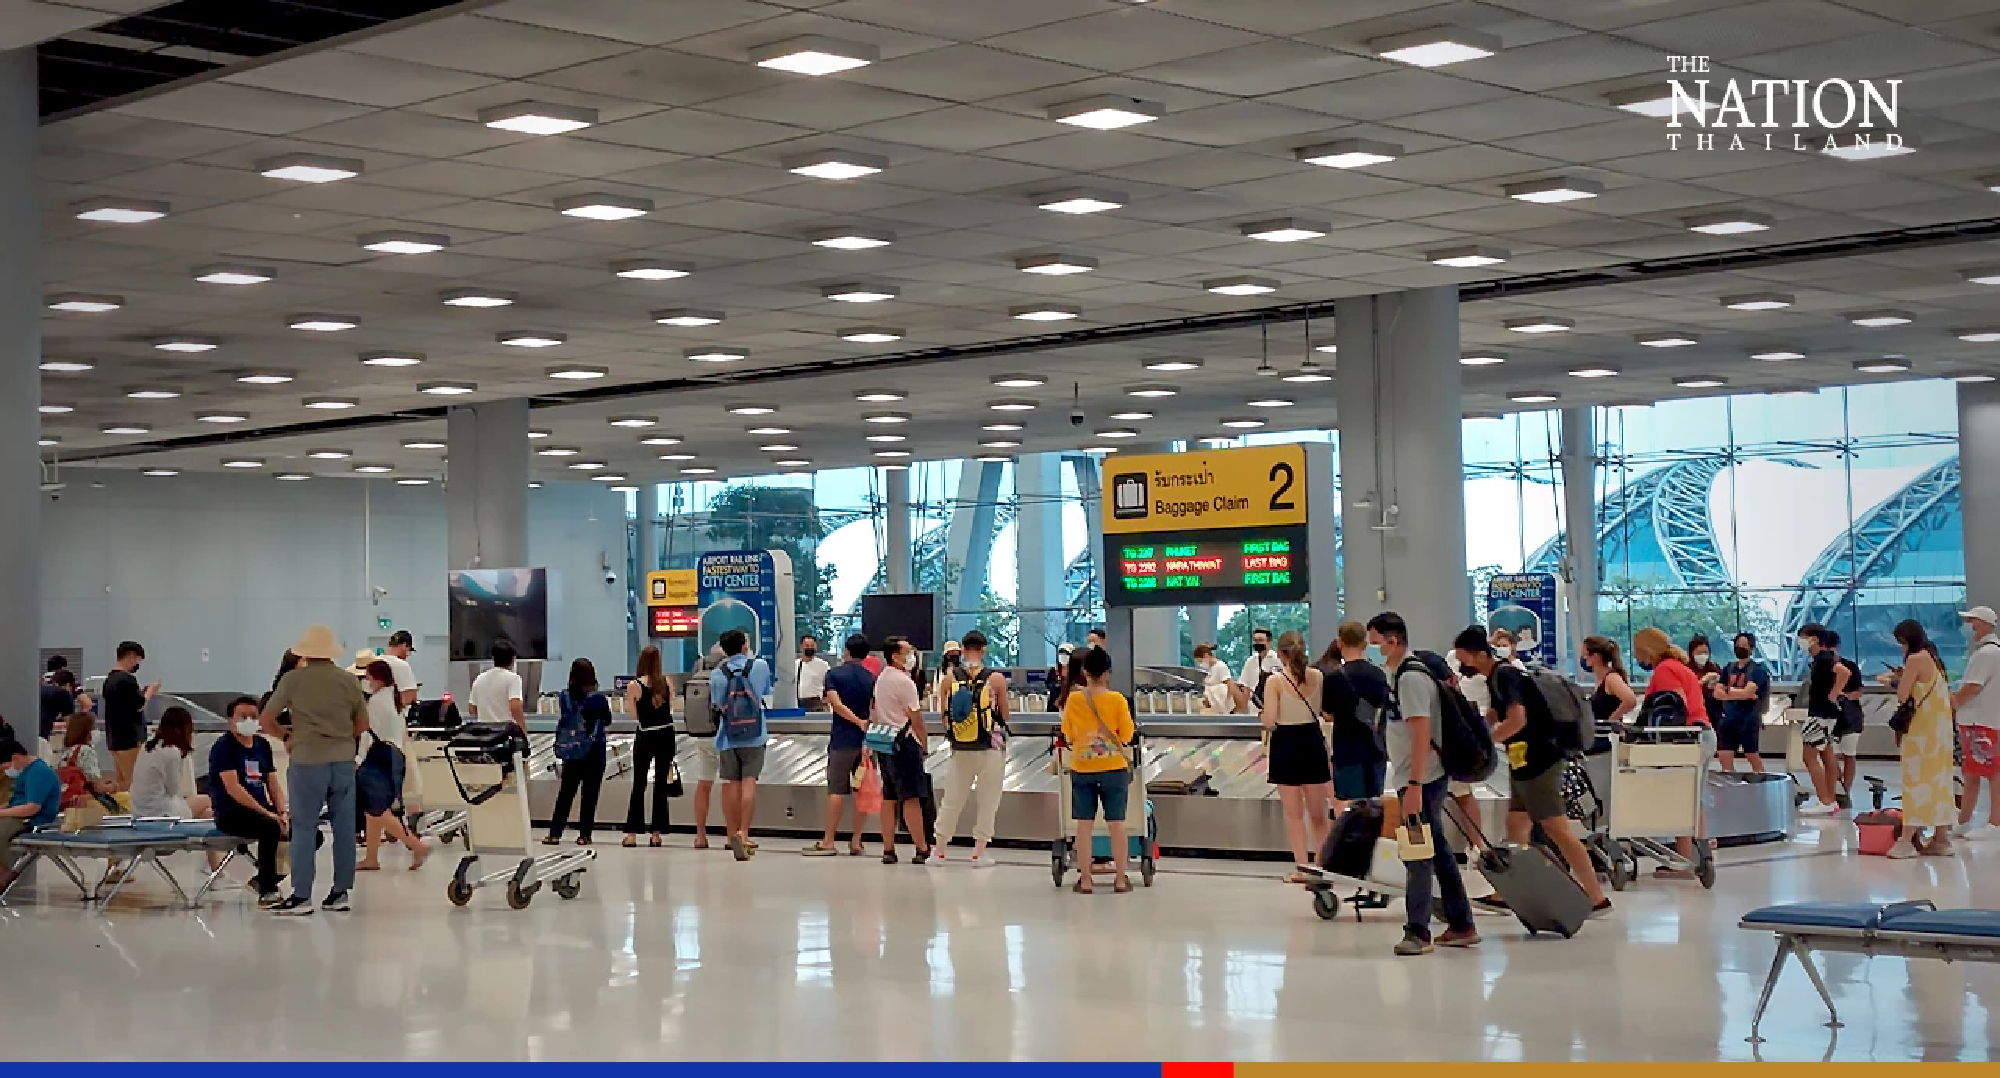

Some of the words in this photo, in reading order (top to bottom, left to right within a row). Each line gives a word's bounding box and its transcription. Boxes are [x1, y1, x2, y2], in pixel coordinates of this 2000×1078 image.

[1269, 461, 1295, 511] 2
[1156, 500, 1209, 517] Baggage
[1214, 495, 1248, 511] Claim
[1244, 542, 1270, 553] FIRST
[1245, 558, 1267, 569] LAST
[1268, 556, 1288, 568] BAG
[702, 575, 723, 587] CITY
[725, 574, 759, 587] CENTER
[1244, 572, 1270, 585] FIRST
